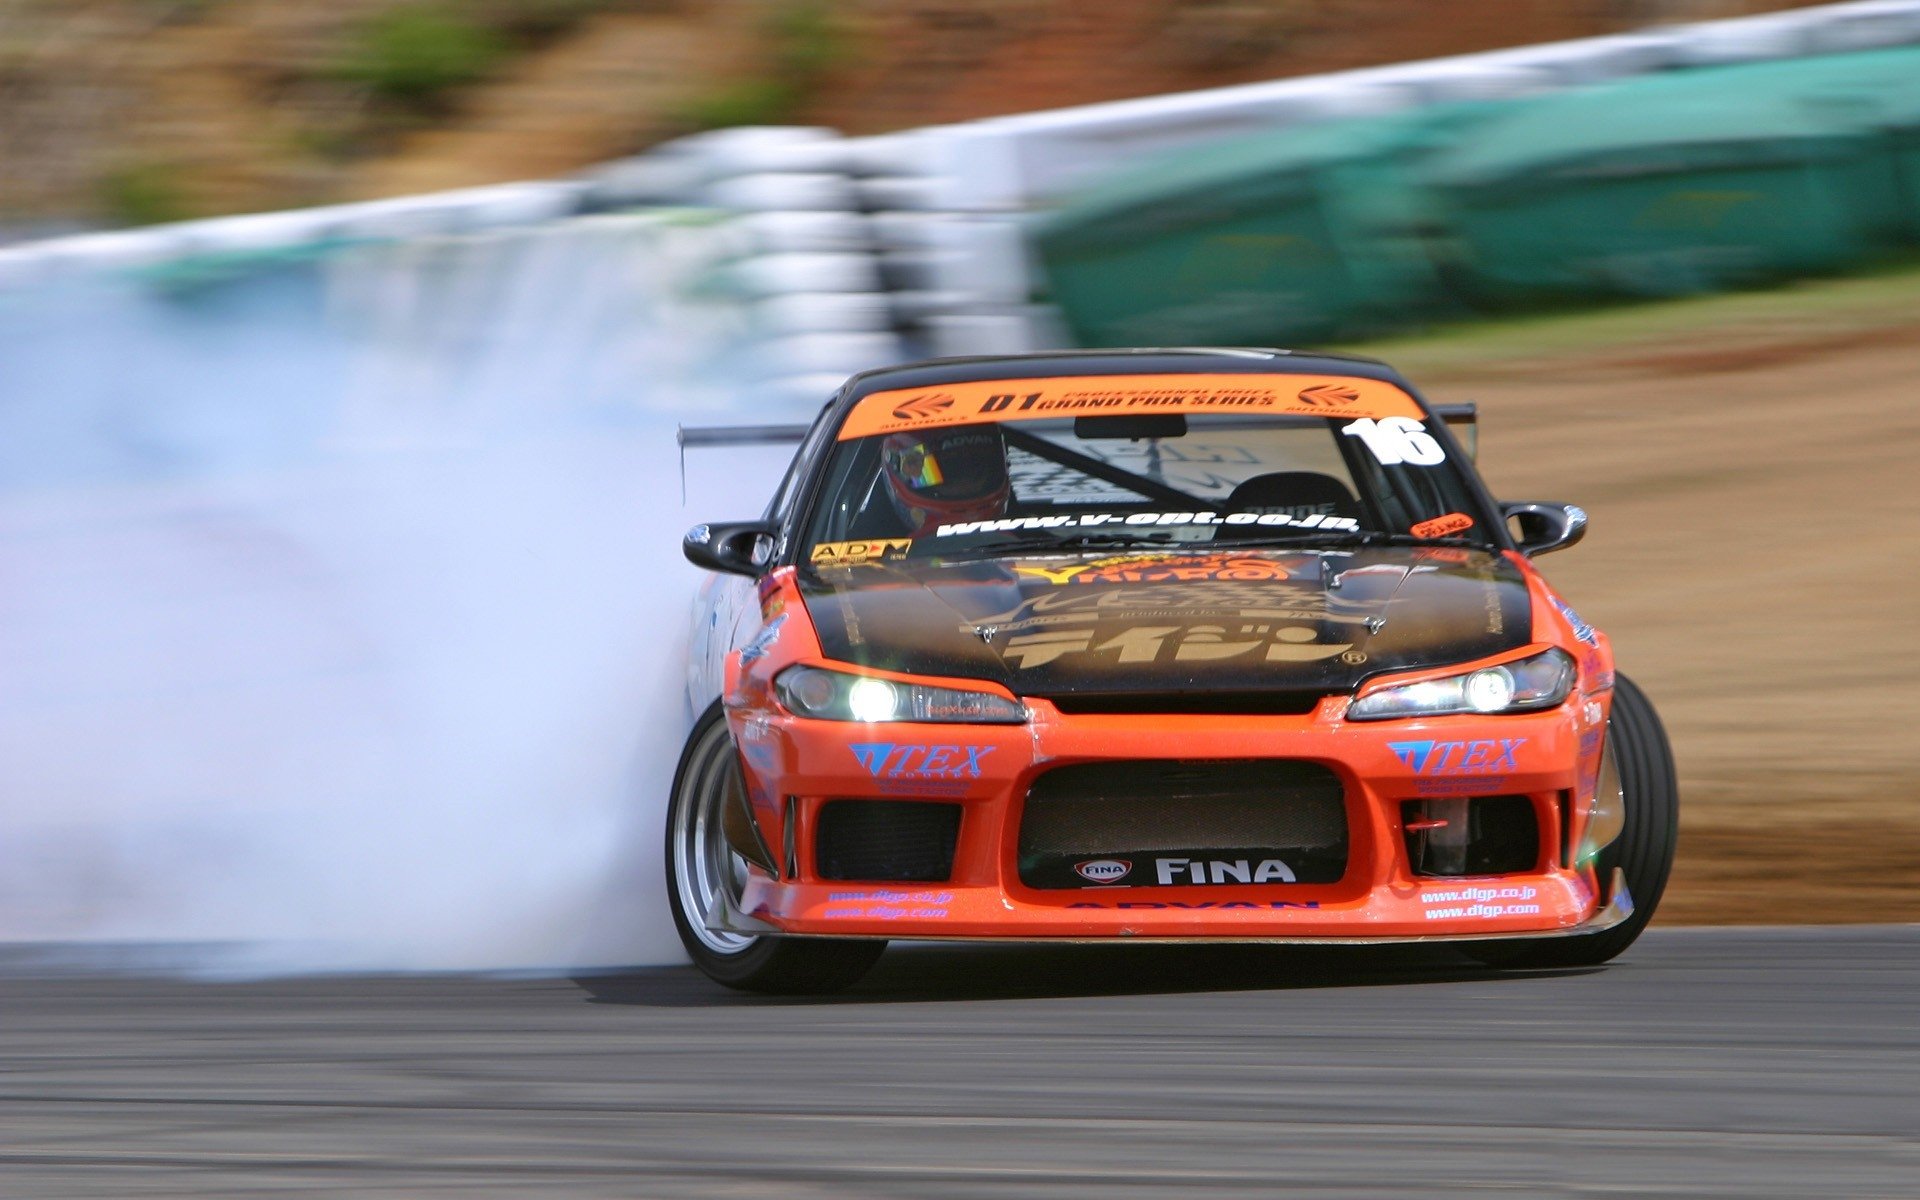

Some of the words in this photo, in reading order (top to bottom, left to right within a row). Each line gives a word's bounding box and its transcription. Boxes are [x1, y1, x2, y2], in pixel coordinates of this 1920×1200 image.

[979, 392, 1043, 413] D1
[1036, 397, 1123, 410] GRAND
[1127, 396, 1185, 406] PRIX
[1191, 396, 1276, 405] SERIES
[1341, 416, 1446, 466] 16
[1085, 865, 1124, 875] FINA
[1155, 858, 1296, 885] FINA
[1064, 901, 1320, 909] ADVAN
